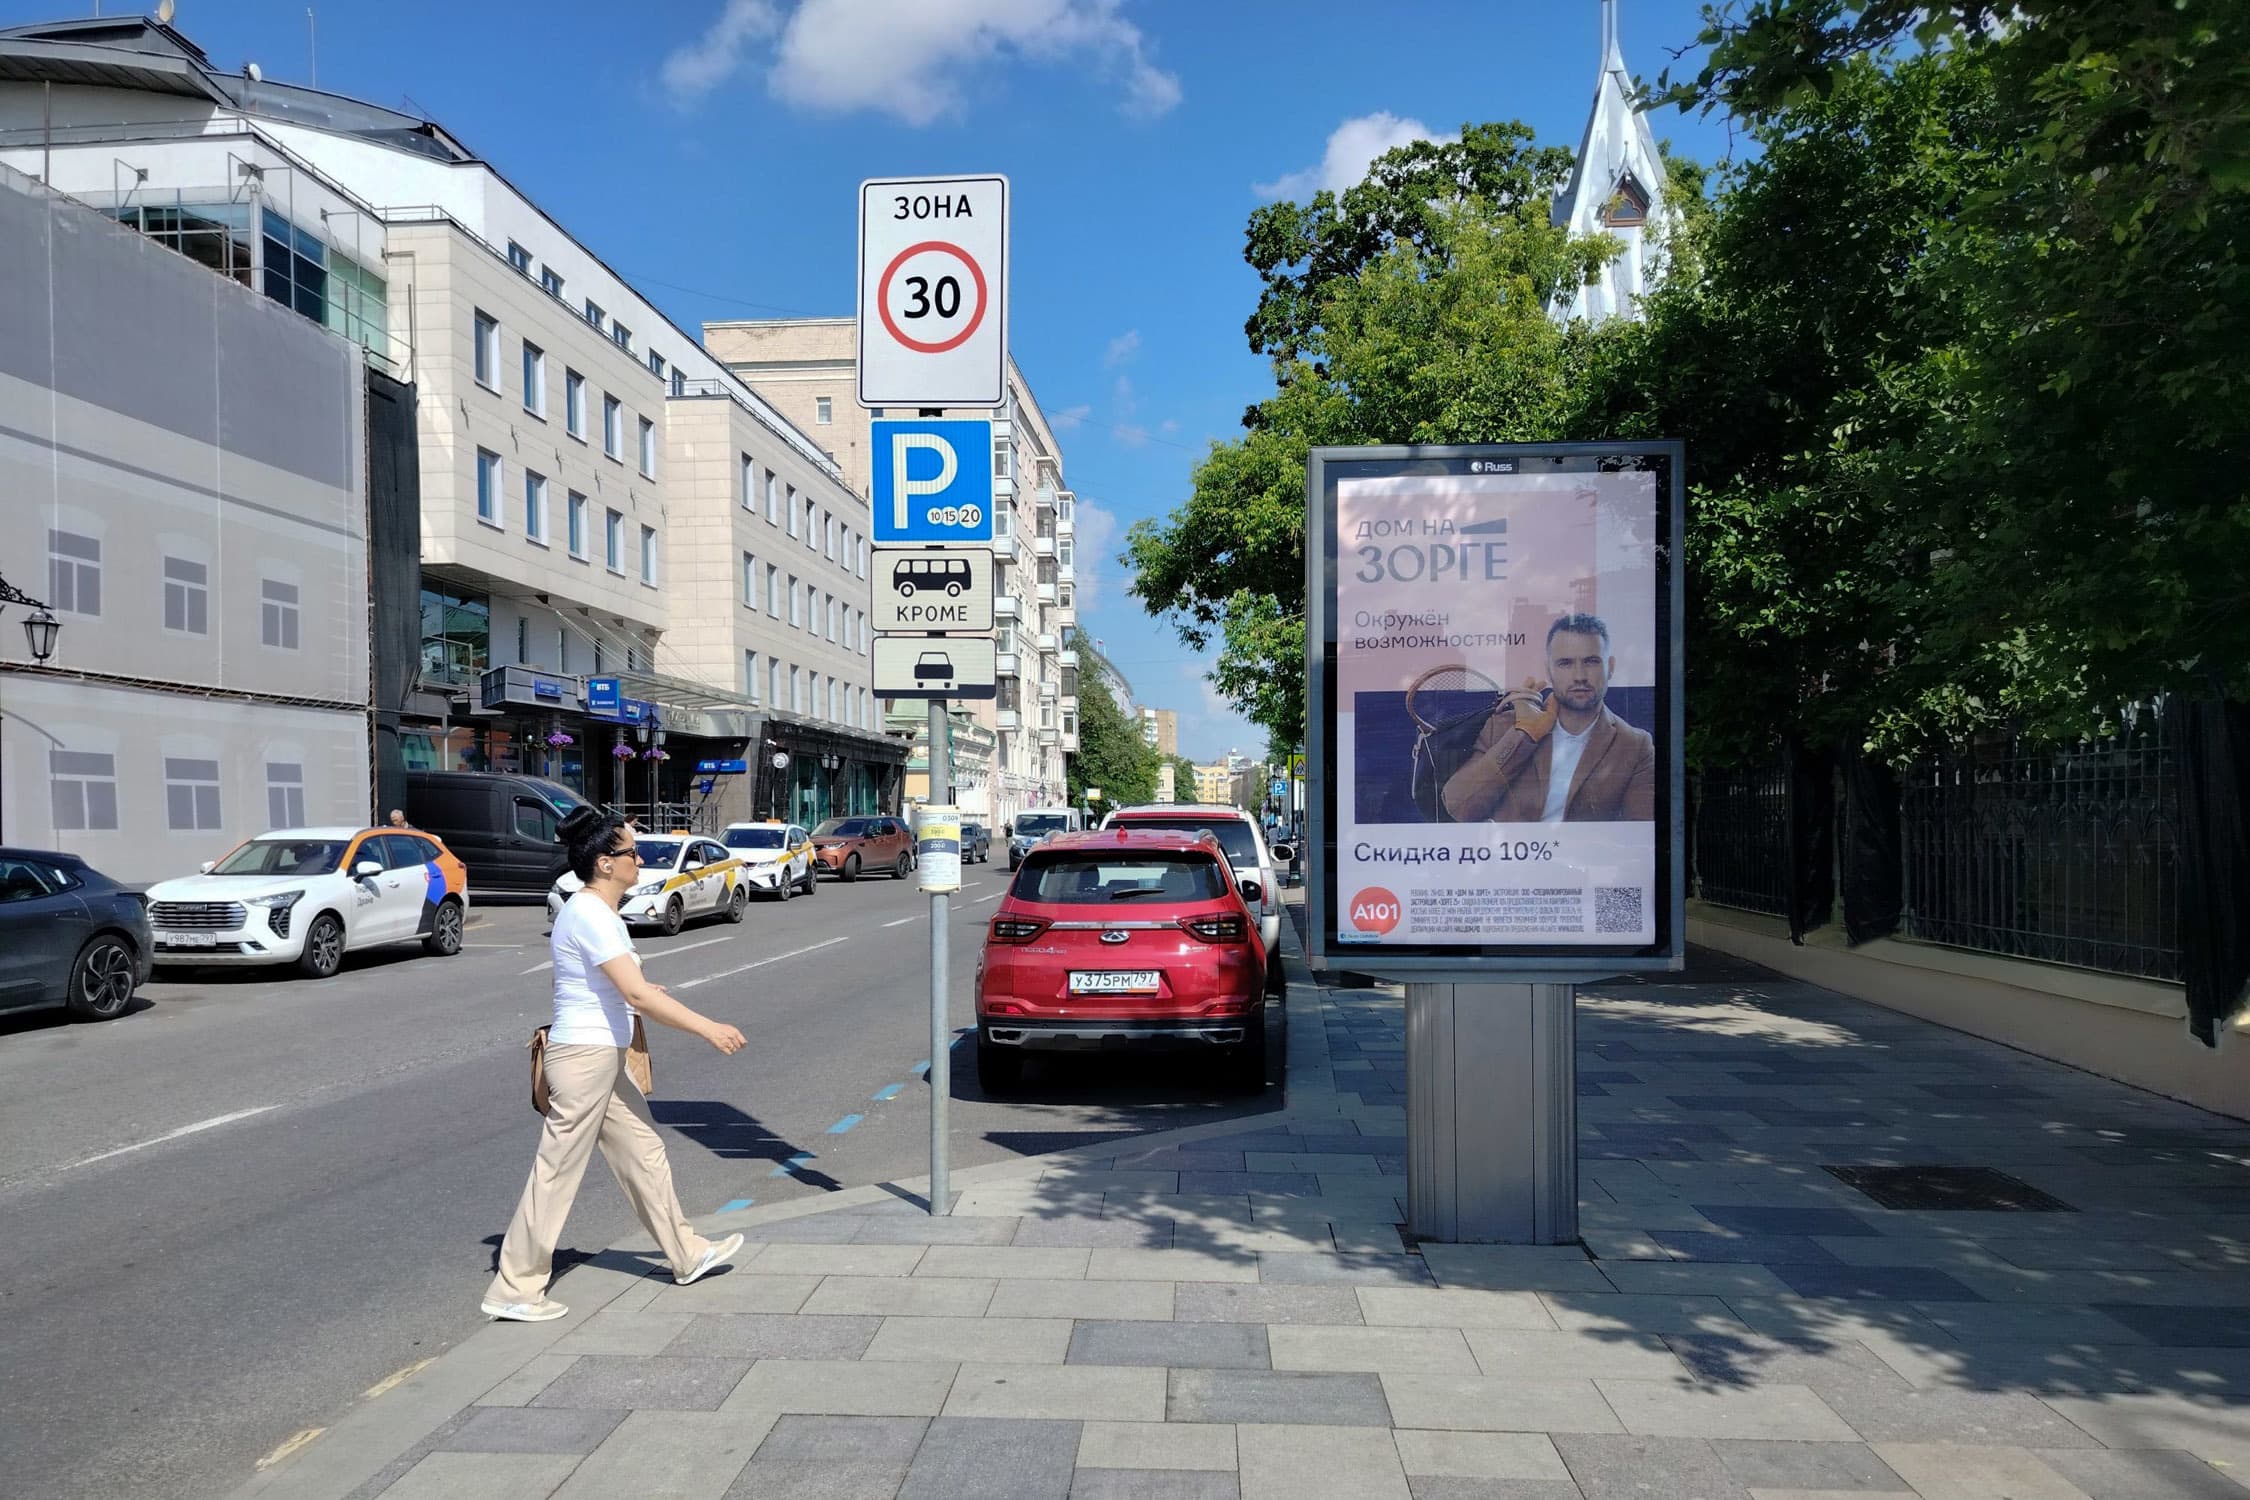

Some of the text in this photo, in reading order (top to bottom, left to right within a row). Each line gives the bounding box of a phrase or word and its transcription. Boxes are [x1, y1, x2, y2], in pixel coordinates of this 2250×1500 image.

[893, 194, 973, 220] ЗОНА
[903, 275, 961, 319] 30
[1484, 461, 1513, 472] Russ
[892, 433, 959, 529] P
[931, 508, 980, 523] 10 15 20
[1355, 518, 1456, 540] ДОМ НА
[1355, 541, 1508, 584] ЗОРГЕ
[896, 605, 968, 622] КРОМЕ
[1354, 609, 1450, 632] Окружён
[1354, 632, 1526, 650] возможностями
[596, 683, 610, 691] ВТБ
[1353, 842, 1451, 865] Скидка
[1458, 846, 1492, 865] до
[1353, 903, 1398, 920] A101
[1075, 972, 1154, 987] У375РМ 797
